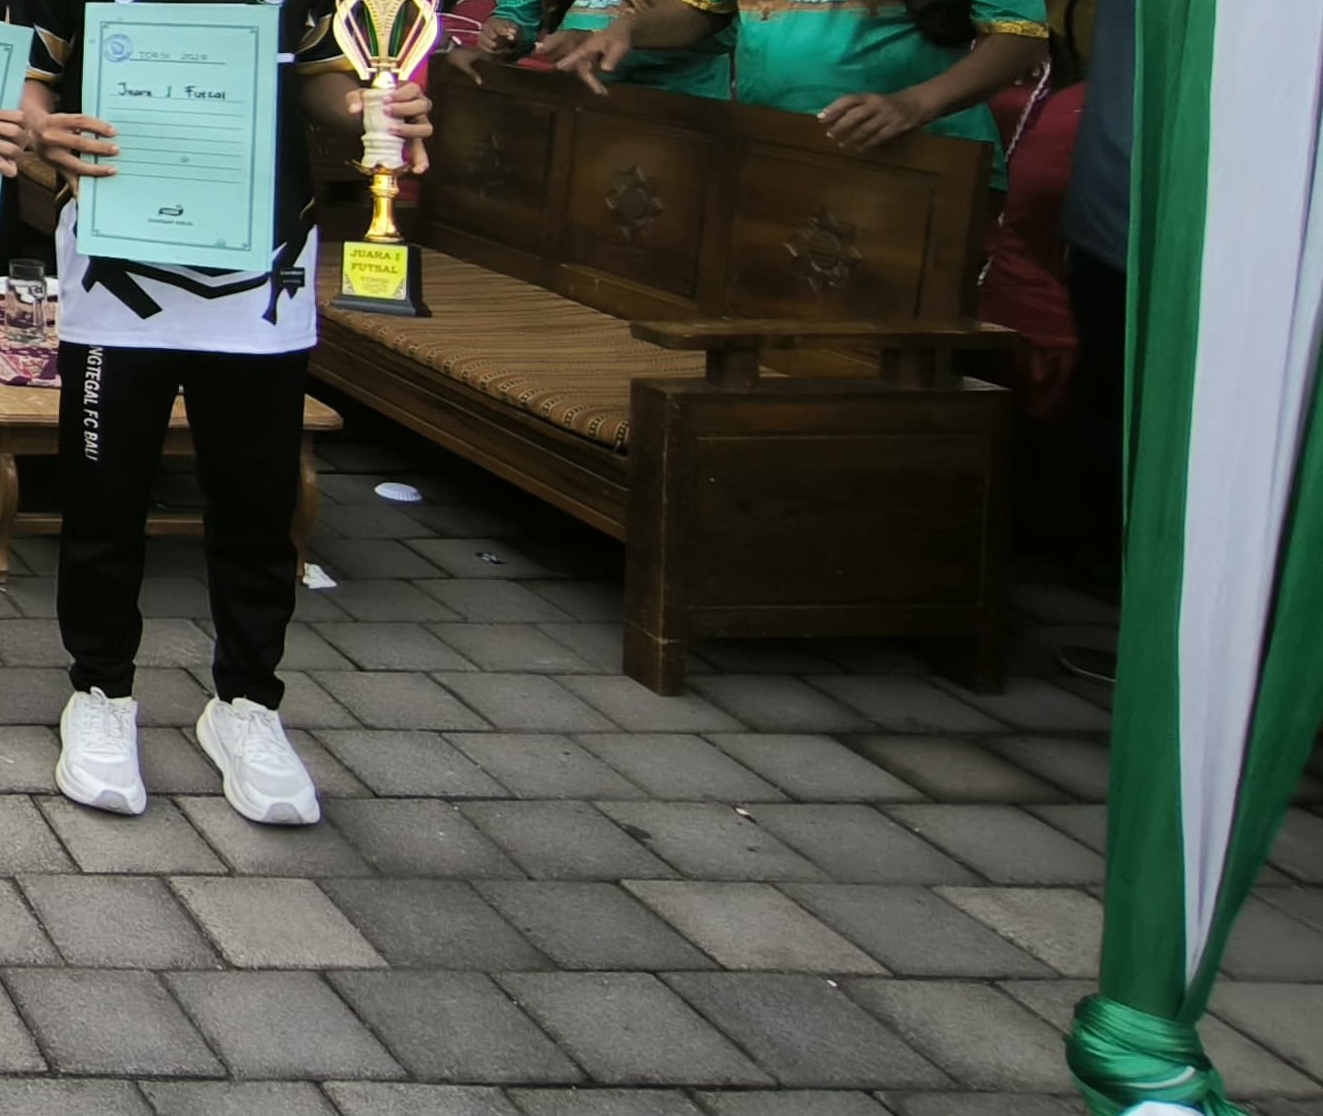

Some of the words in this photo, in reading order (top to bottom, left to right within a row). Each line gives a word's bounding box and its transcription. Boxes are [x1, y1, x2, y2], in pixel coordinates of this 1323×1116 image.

[349, 249, 391, 261] JUARA
[350, 262, 398, 274] FUTSAL
[83, 408, 99, 428] FC
[83, 430, 99, 461] BALI
